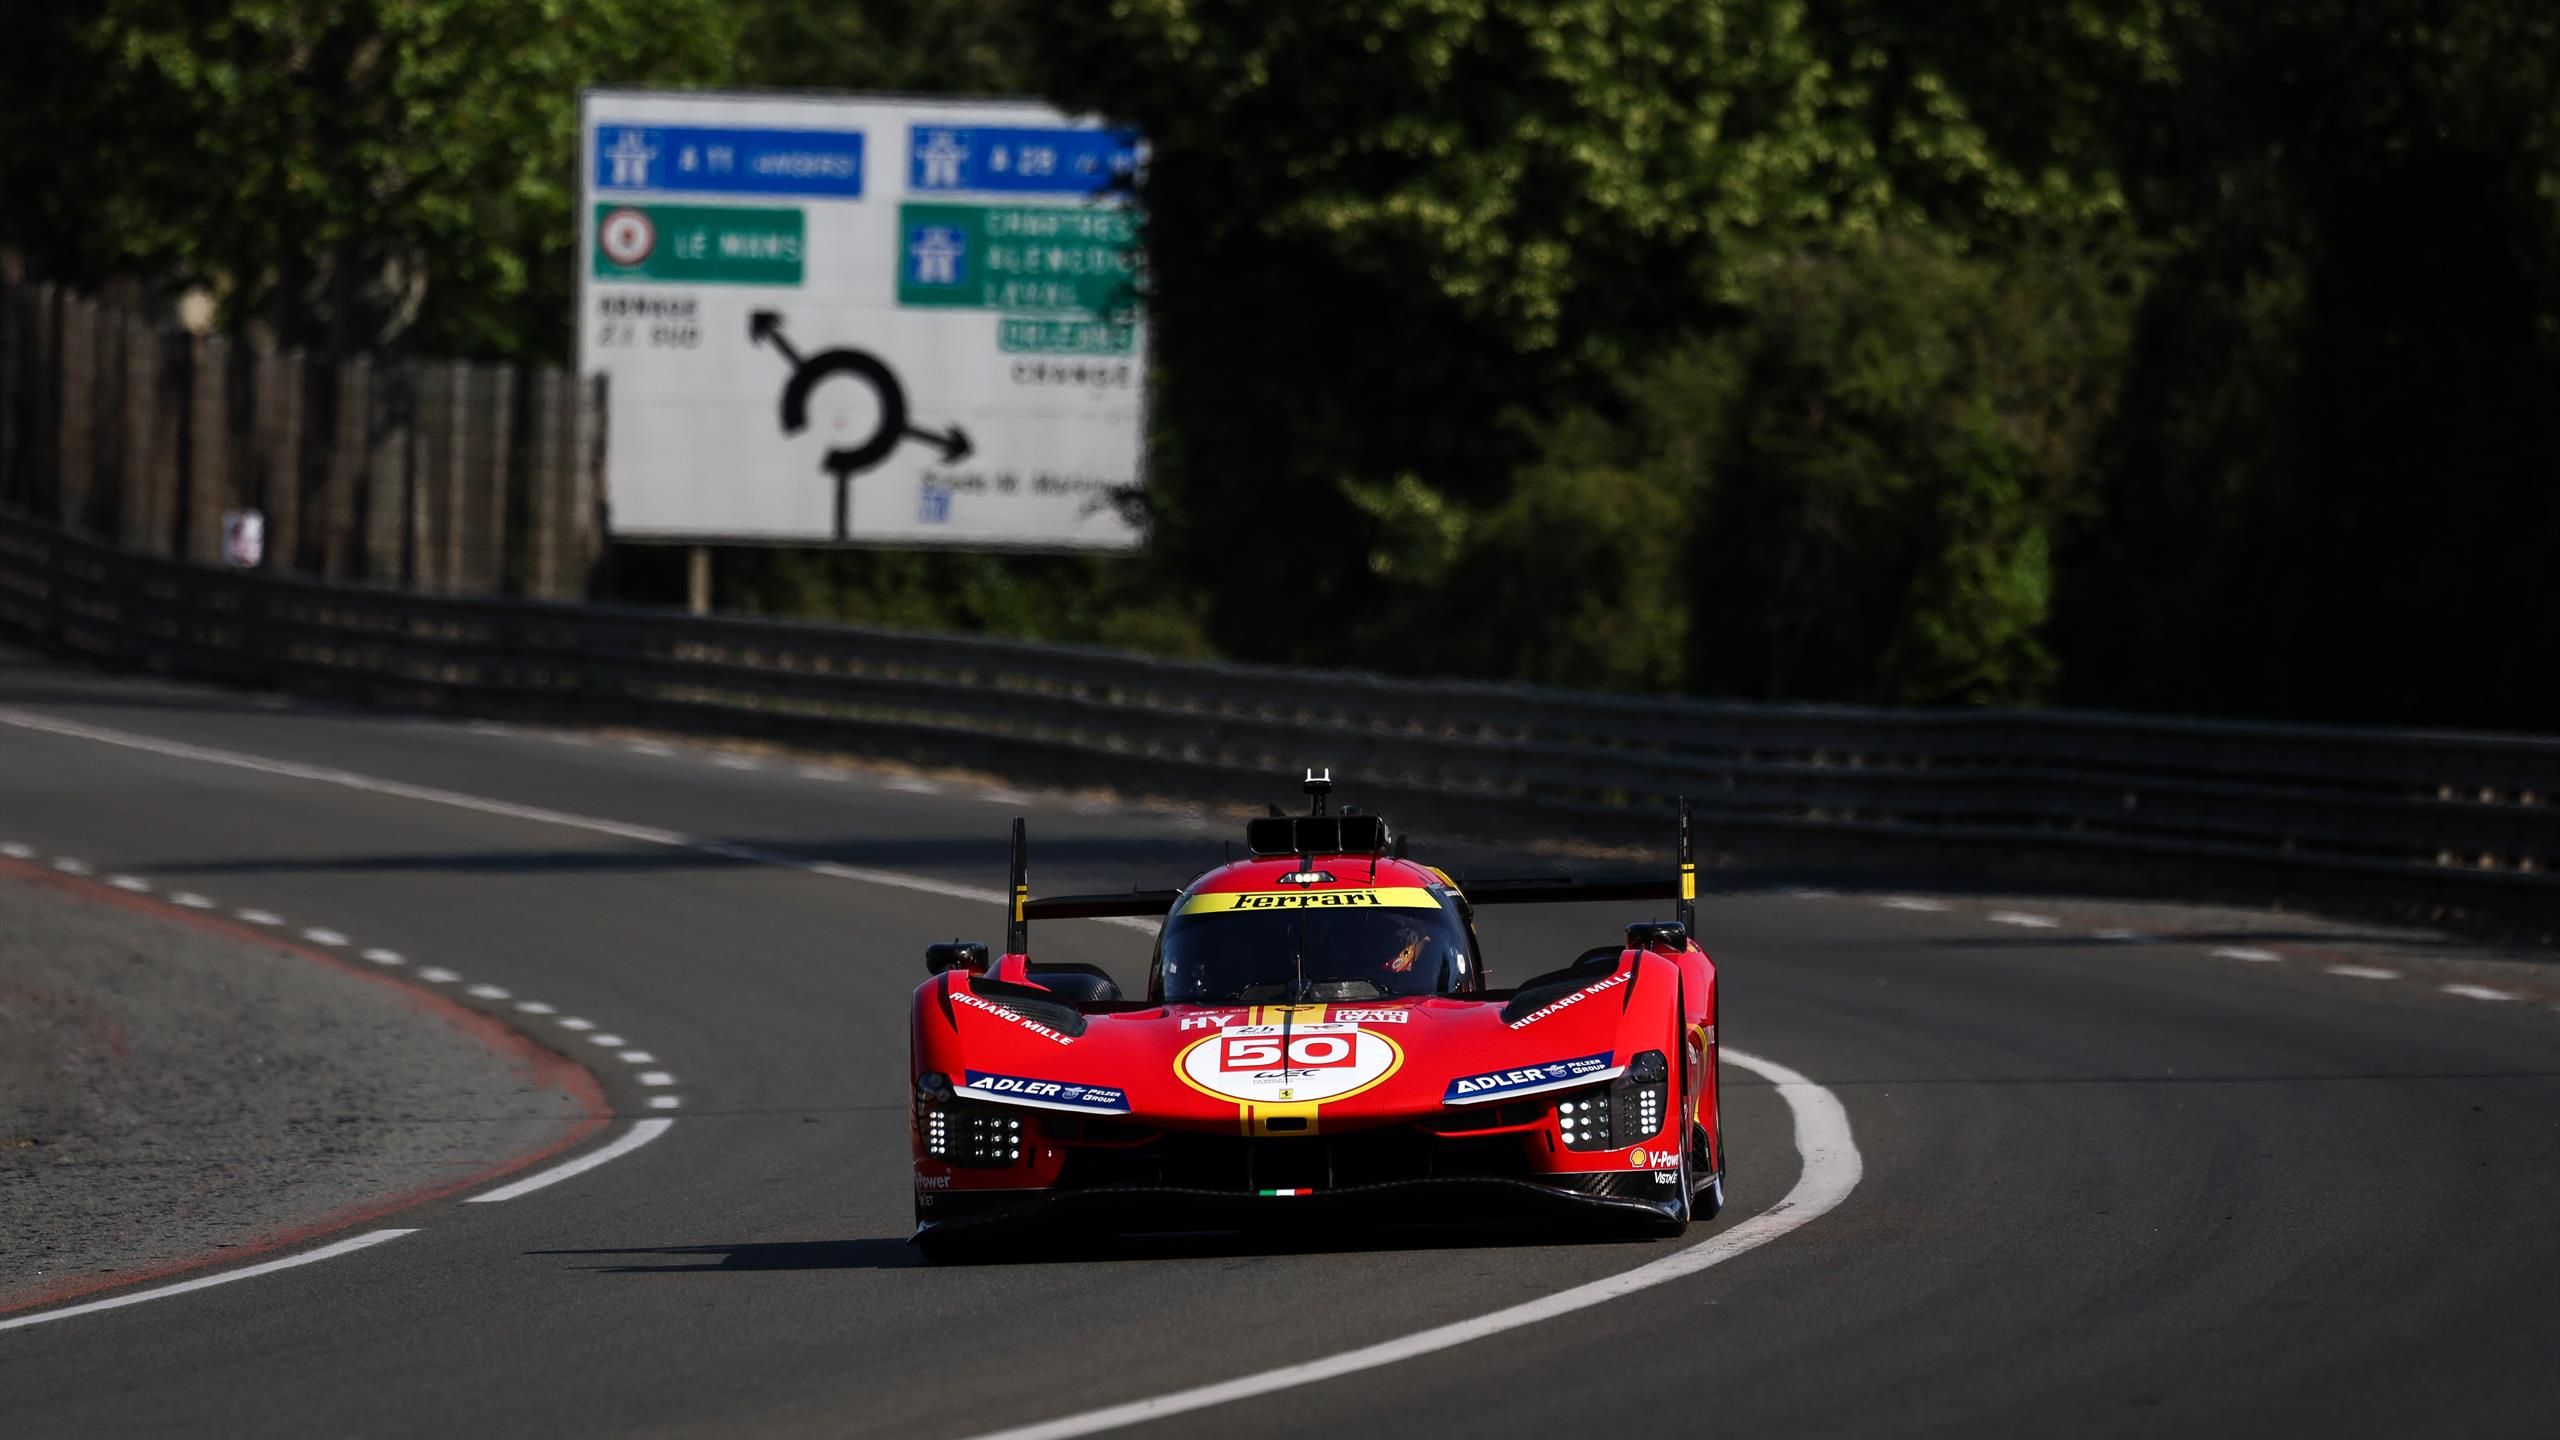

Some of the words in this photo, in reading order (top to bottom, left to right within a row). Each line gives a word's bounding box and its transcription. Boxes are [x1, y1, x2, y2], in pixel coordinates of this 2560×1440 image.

[1229, 890, 1382, 909] Ferrari
[1510, 992, 1586, 1031] RICHARD
[1586, 971, 1634, 995] MILLE
[950, 992, 1020, 1023] RICHARD
[1020, 1020, 1074, 1046] MILLE
[1180, 1013, 1236, 1031] HY
[1228, 1037, 1350, 1068] 50
[968, 1076, 1062, 1096] ADLER
[1457, 1068, 1546, 1094] ADLER
